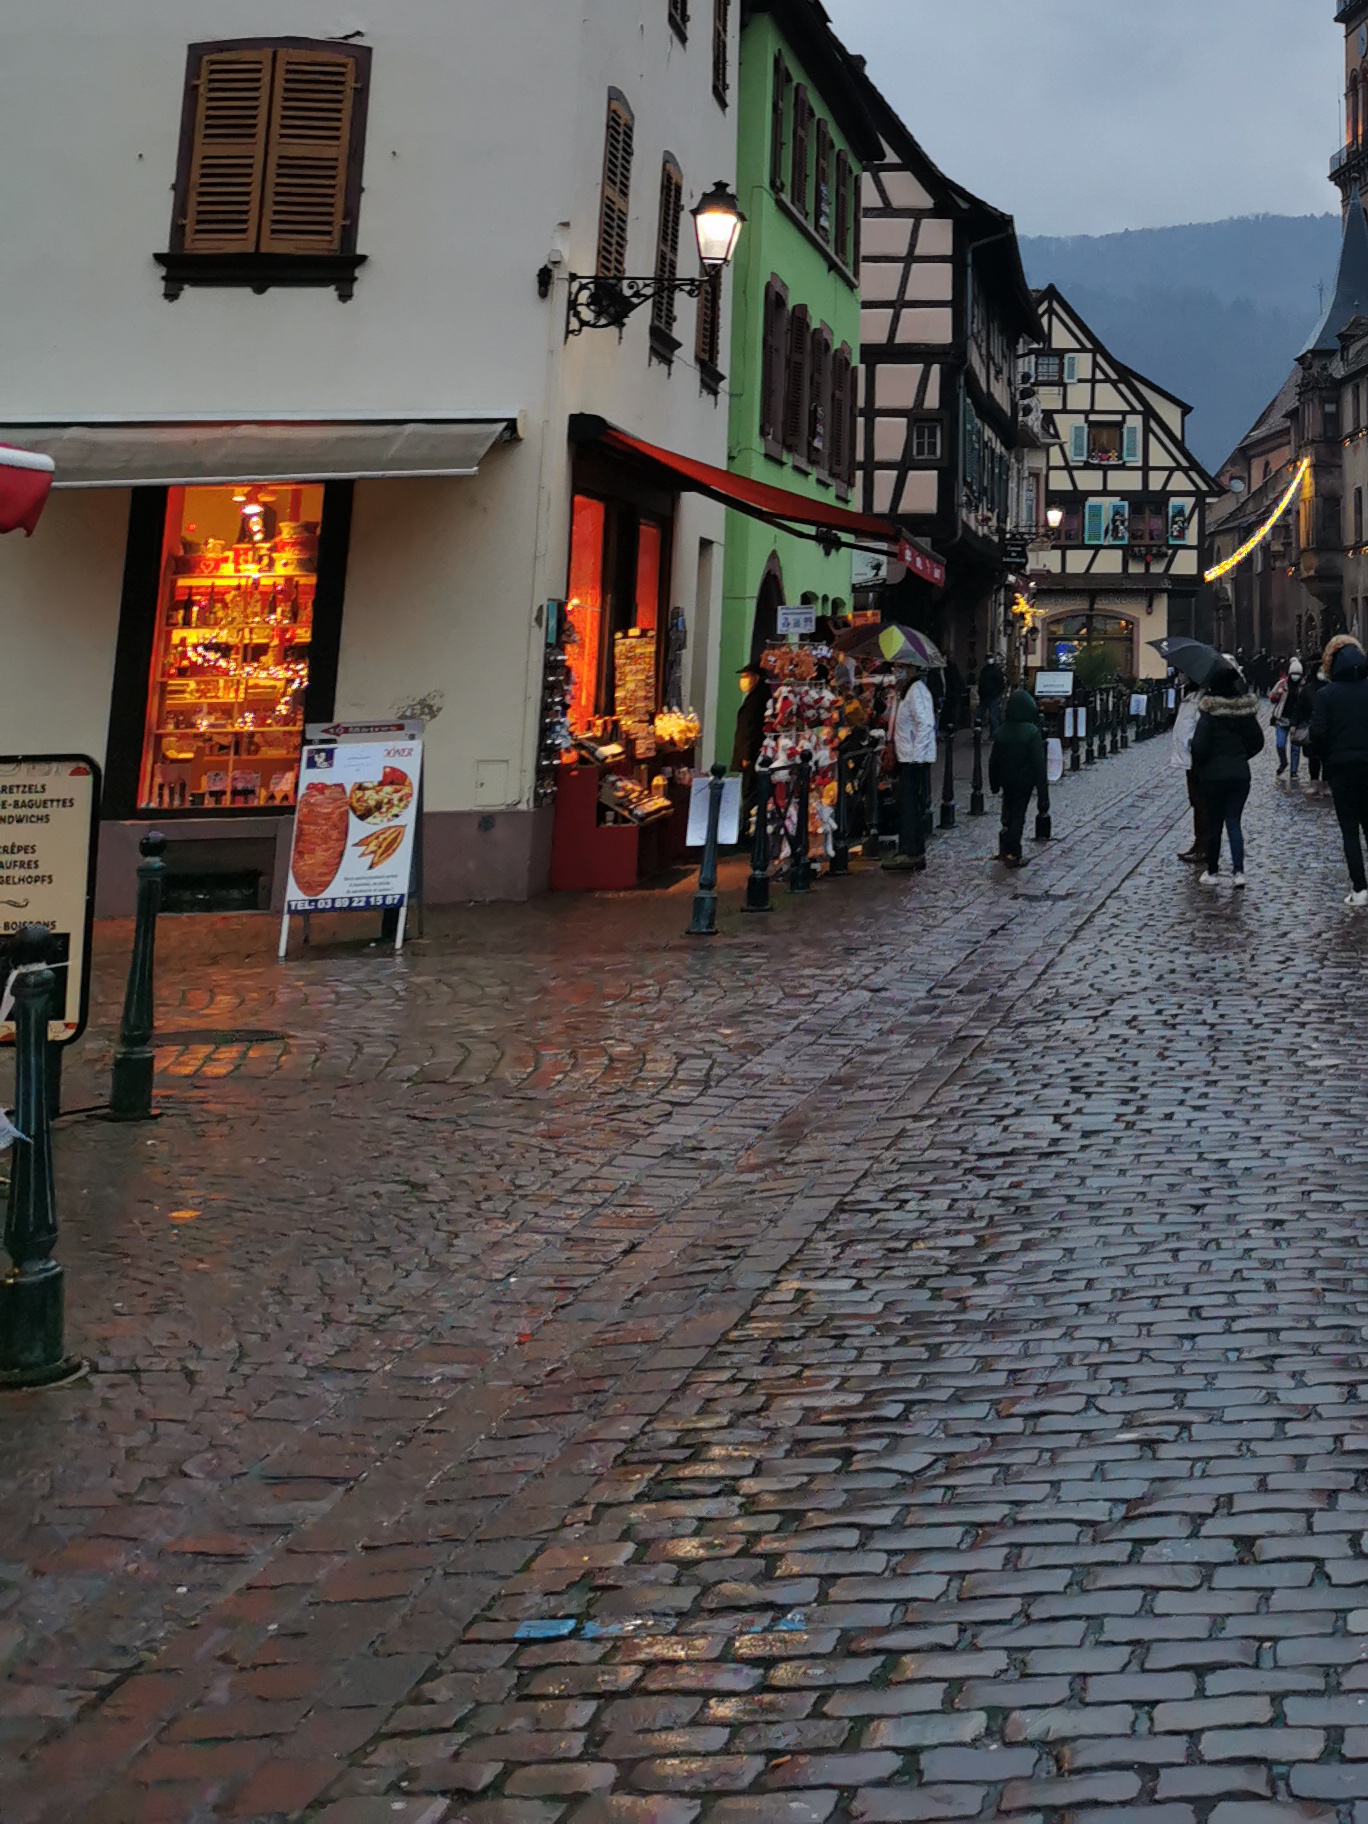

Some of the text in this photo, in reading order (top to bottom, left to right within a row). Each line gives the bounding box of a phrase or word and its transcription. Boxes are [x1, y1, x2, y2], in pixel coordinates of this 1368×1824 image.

[0, 783, 47, 795] RETZELS
[316, 898, 332, 909] 03
[333, 897, 350, 908] 89
[351, 896, 366, 907] 22
[369, 895, 383, 906] 15
[384, 894, 401, 905] 87
